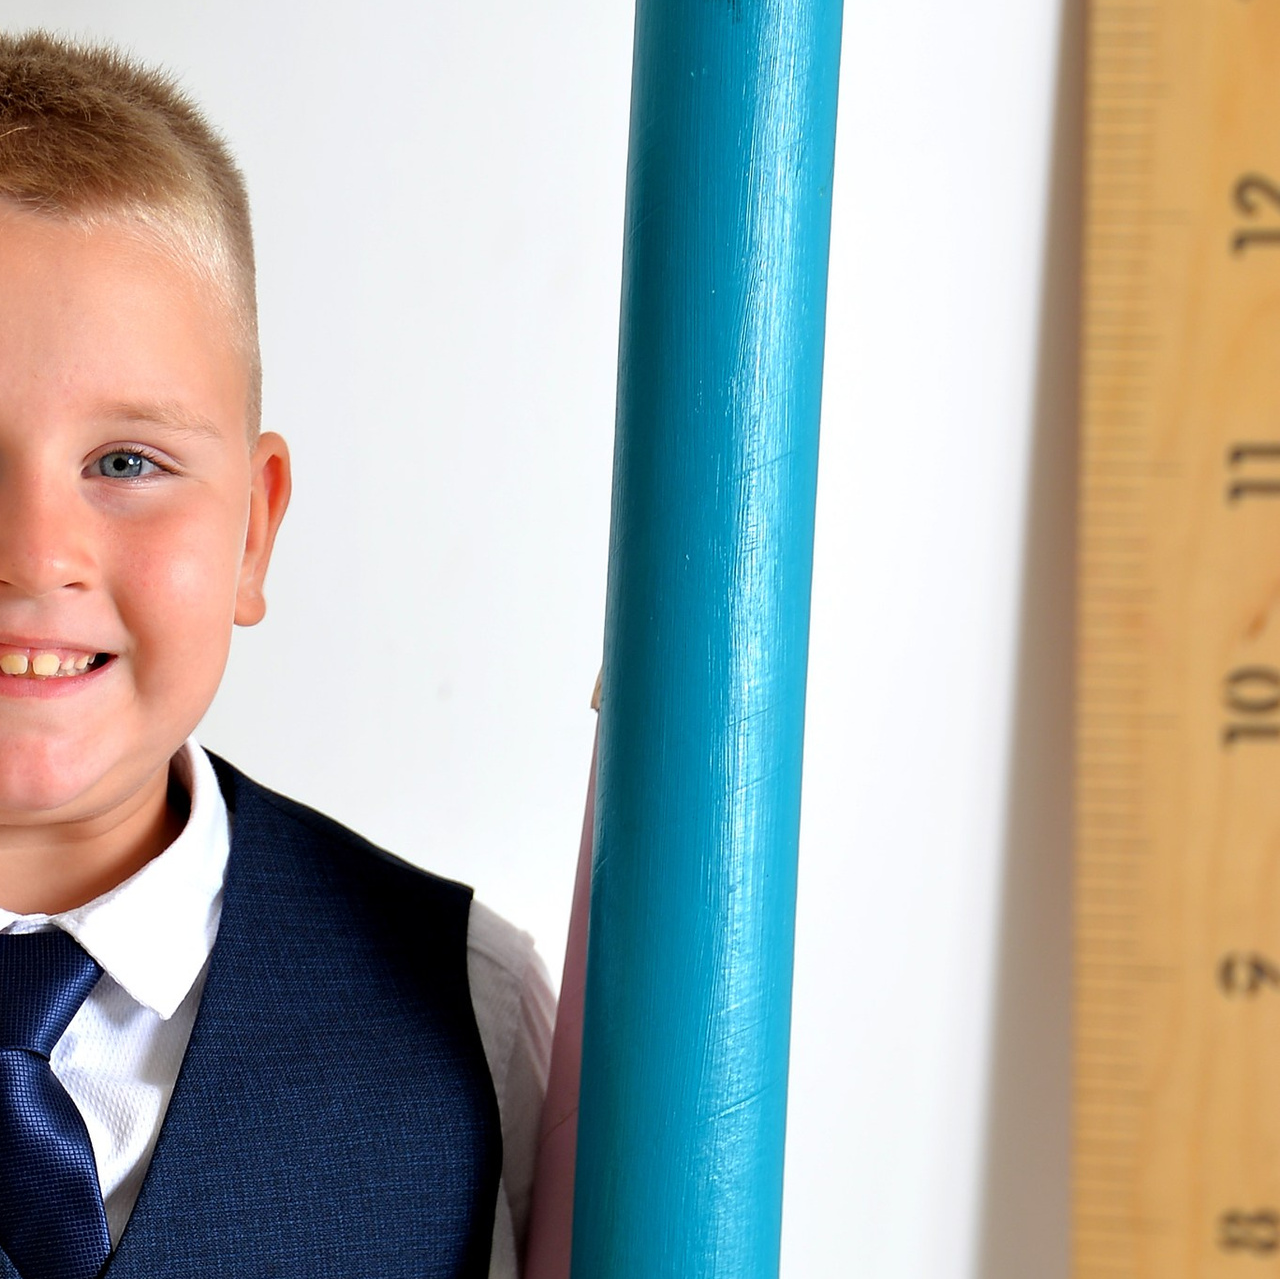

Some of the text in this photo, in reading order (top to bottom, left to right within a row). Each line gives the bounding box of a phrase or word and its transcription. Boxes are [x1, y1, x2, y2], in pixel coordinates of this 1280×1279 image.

[1233, 175, 1280, 257] 12
[1227, 443, 1280, 507] 11
[1222, 667, 1280, 751] 10
[1219, 953, 1280, 999] 9
[1219, 1210, 1280, 1254] 8
